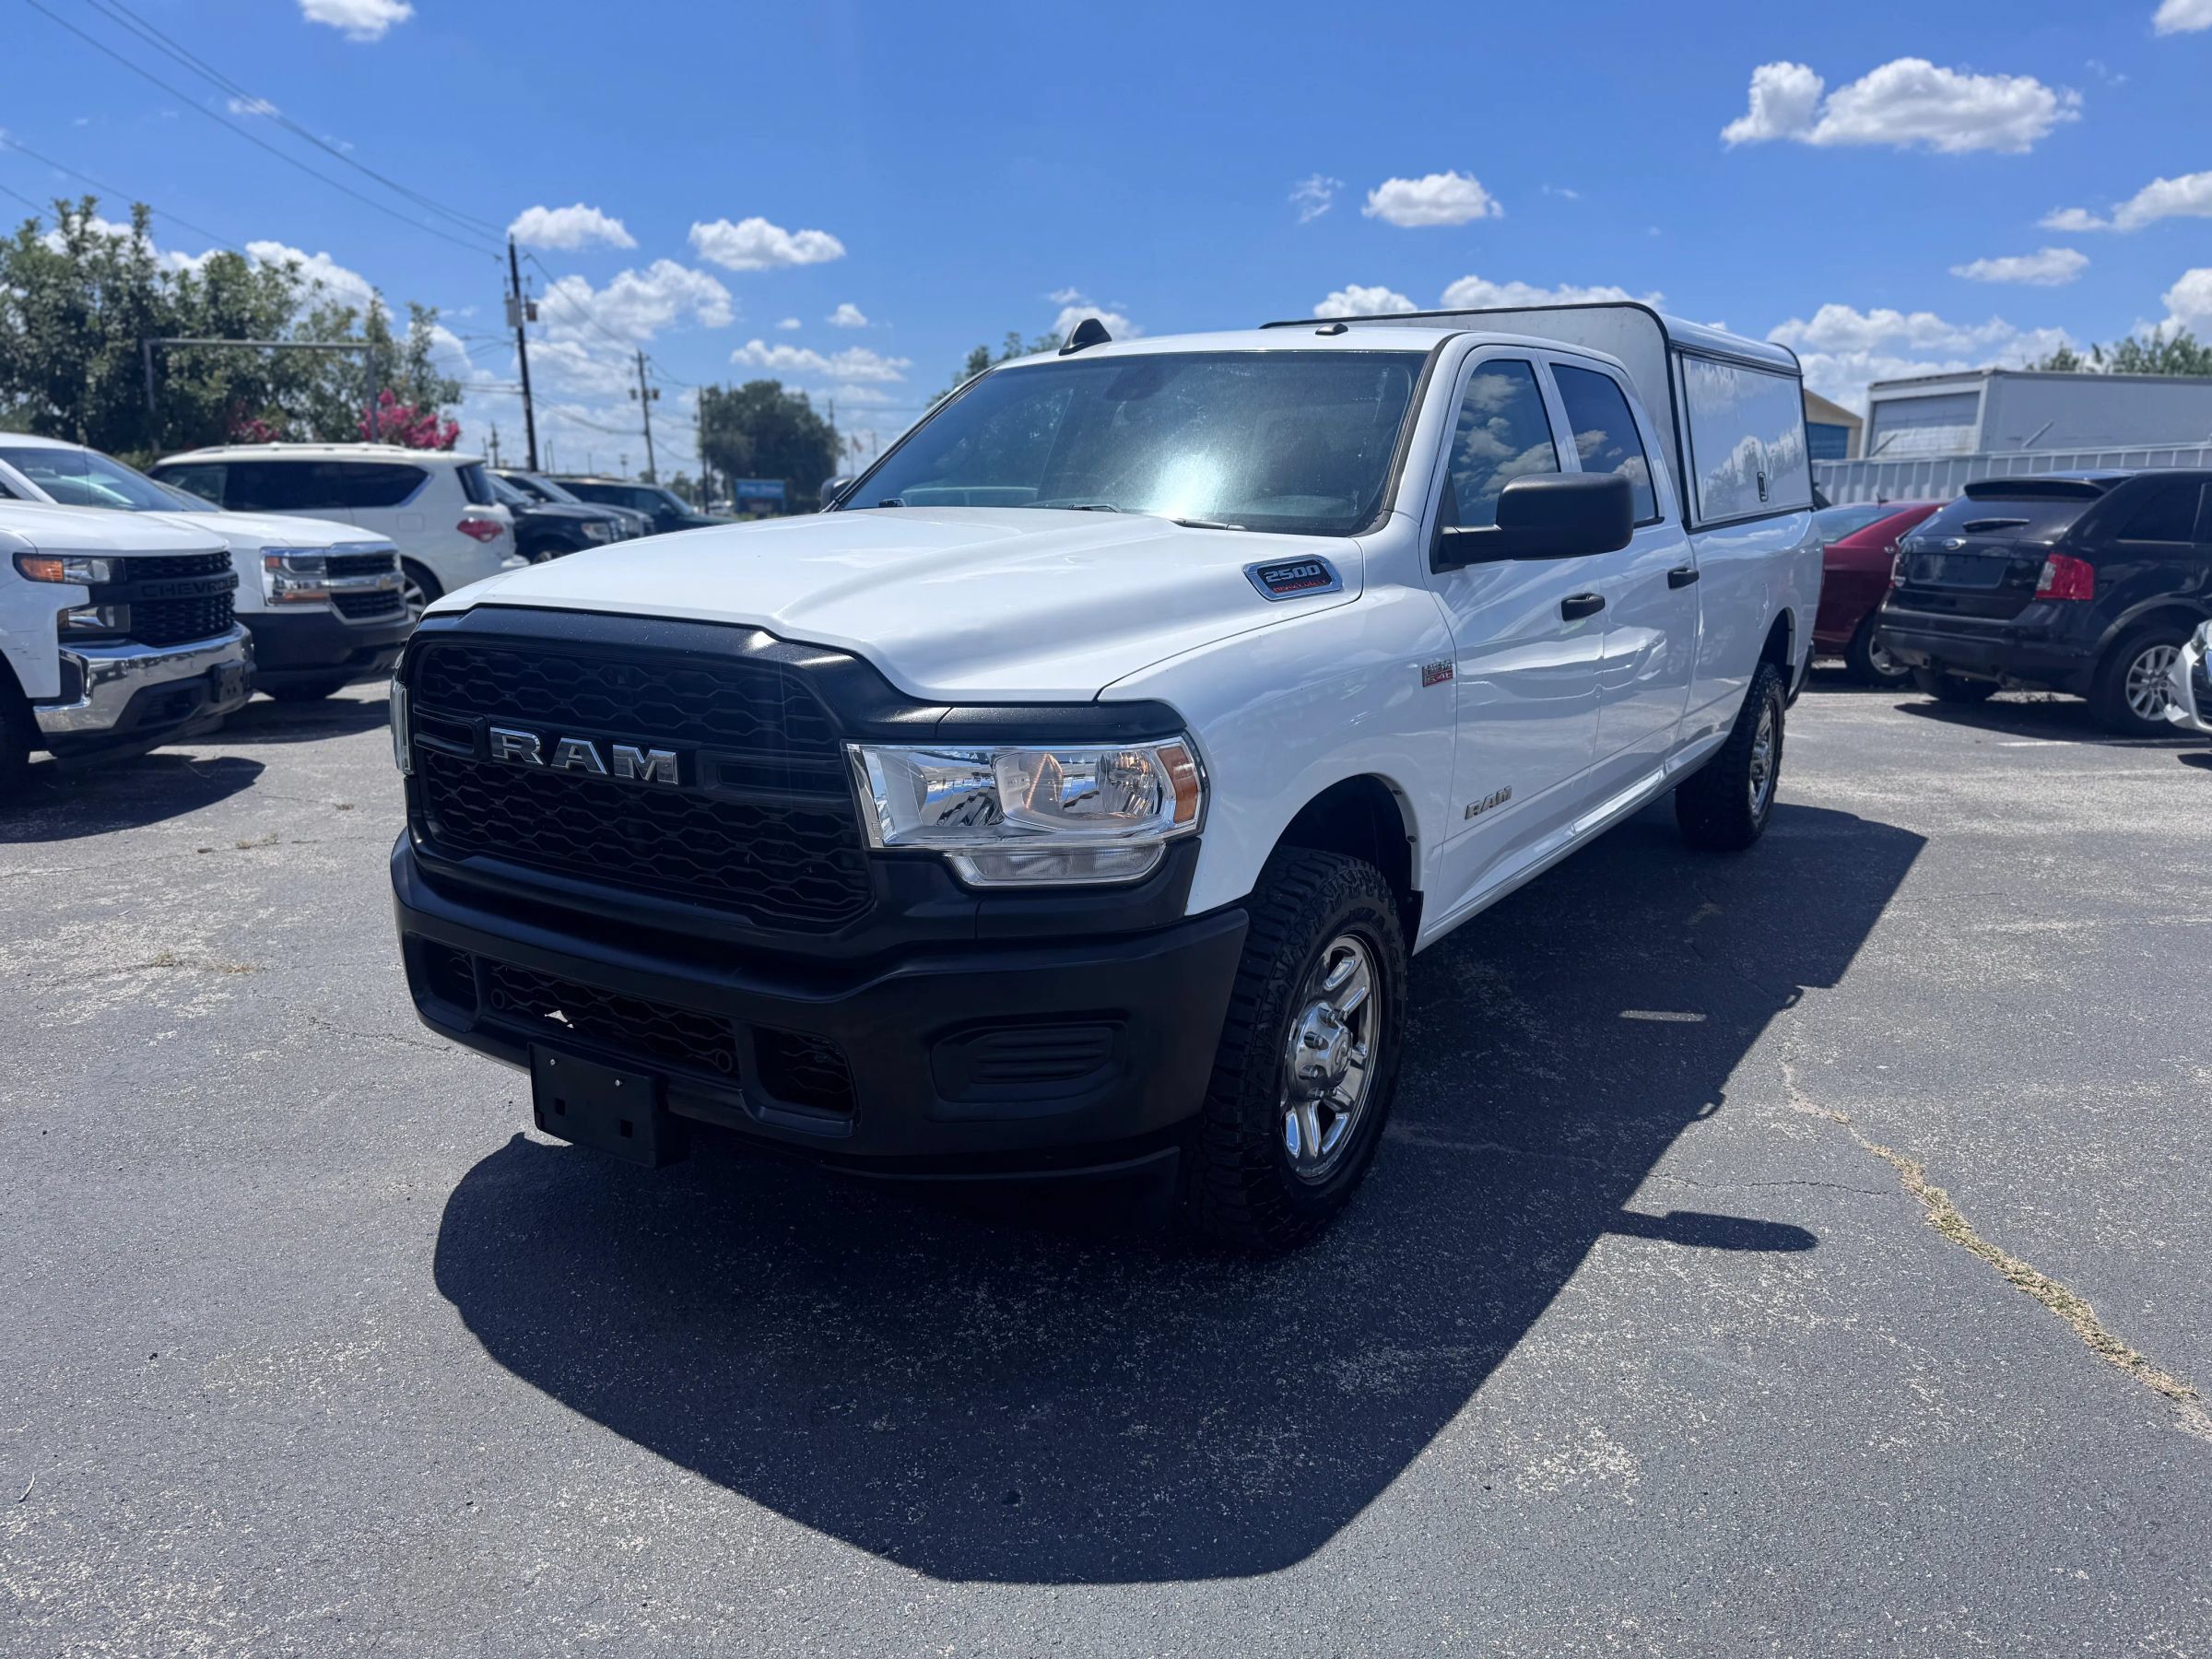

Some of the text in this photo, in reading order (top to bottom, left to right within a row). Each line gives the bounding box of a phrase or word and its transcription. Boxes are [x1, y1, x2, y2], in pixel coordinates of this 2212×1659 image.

[141, 576, 240, 597] CHEVROLE
[1264, 564, 1321, 582] 2500
[489, 726, 679, 786] RAM
[1465, 784, 1512, 820] RAM
